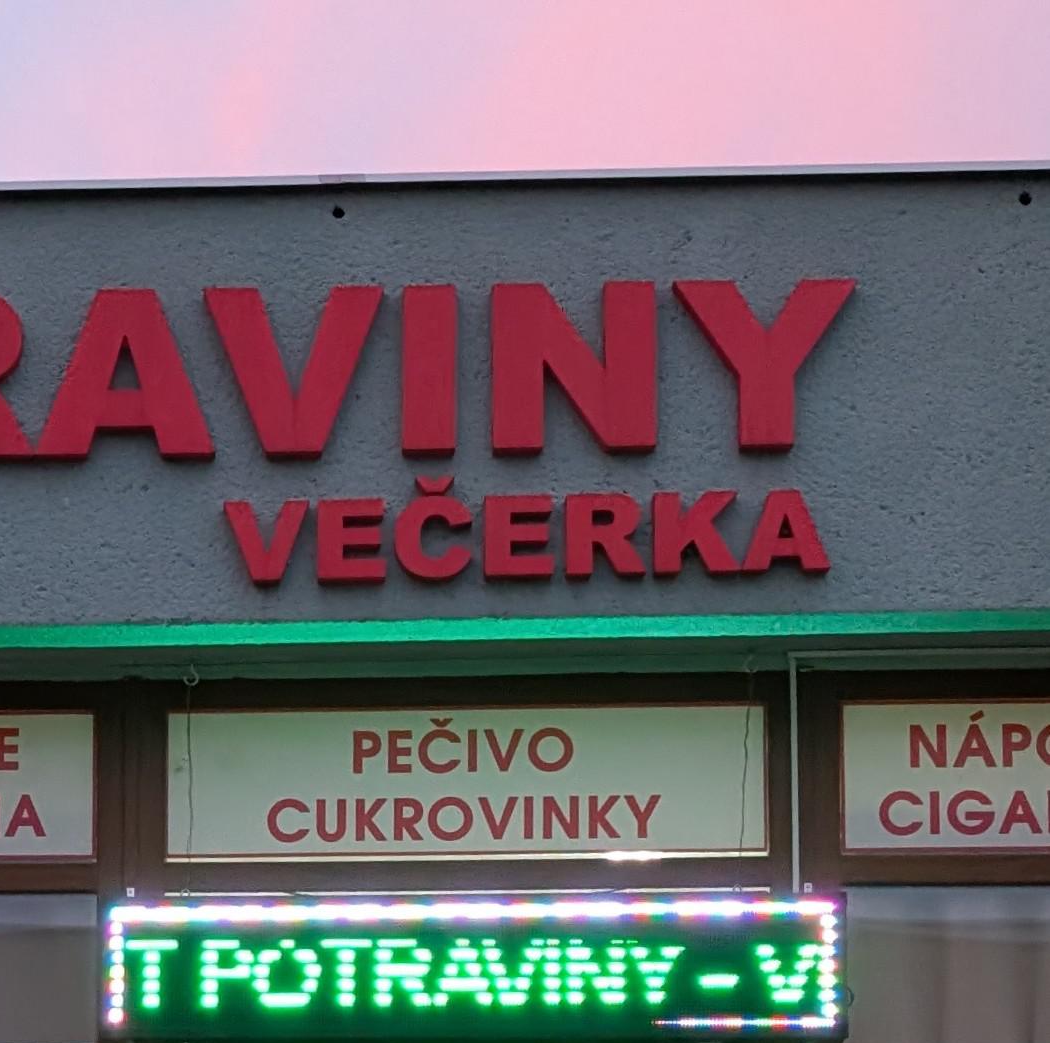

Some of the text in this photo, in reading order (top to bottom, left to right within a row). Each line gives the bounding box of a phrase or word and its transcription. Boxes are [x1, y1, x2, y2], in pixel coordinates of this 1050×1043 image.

[223, 475, 830, 587] VEČERKA
[352, 718, 574, 774] PEČIVO
[267, 794, 662, 842] CUKROVINKY
[879, 790, 1050, 836] CIGA
[200, 938, 685, 1008] POTRAVINY
